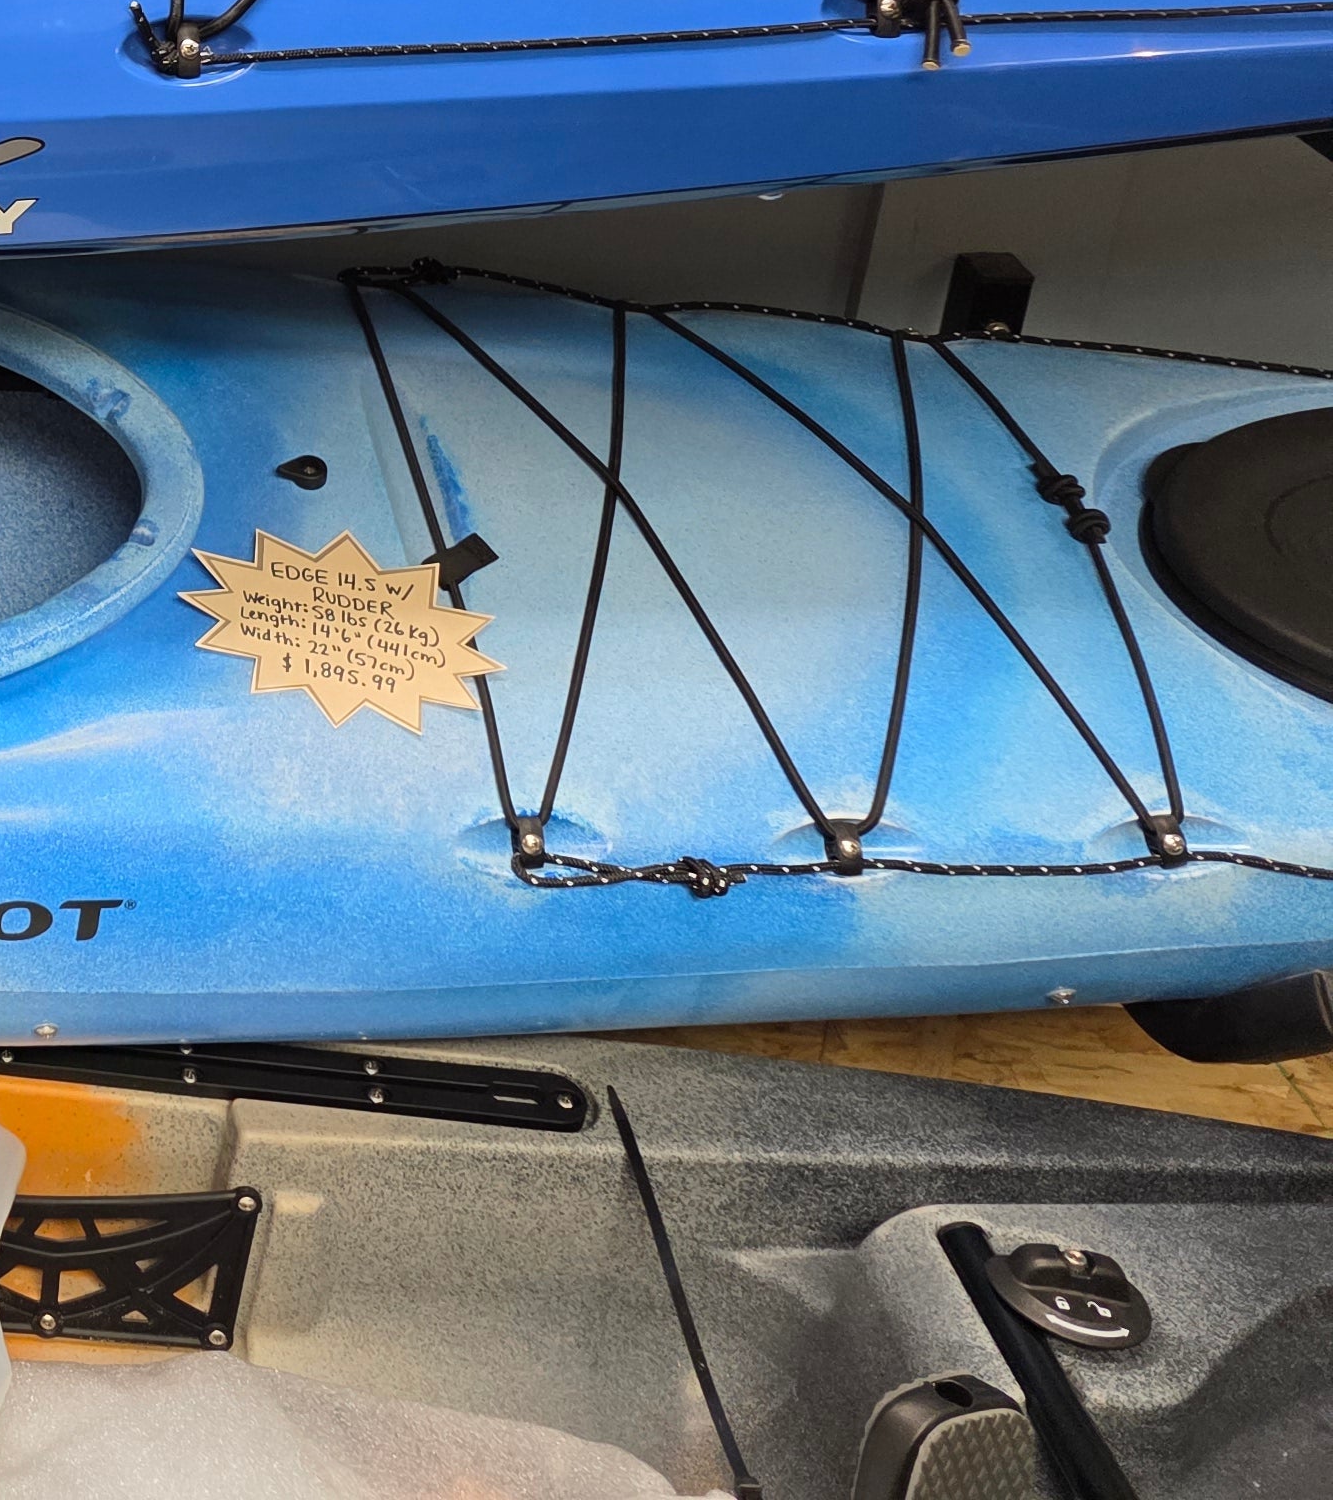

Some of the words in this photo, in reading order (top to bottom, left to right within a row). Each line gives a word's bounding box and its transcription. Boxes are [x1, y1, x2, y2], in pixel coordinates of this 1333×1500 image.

[271, 561, 328, 585] EDGE
[337, 572, 376, 592] 14.5
[240, 606, 307, 630] Length:
[242, 589, 309, 617] Weight:
[311, 605, 335, 622] 58
[340, 611, 367, 628] lbs
[312, 586, 395, 620] RUDDER
[240, 623, 301, 648] Width:
[305, 658, 396, 694] 1,895.99
